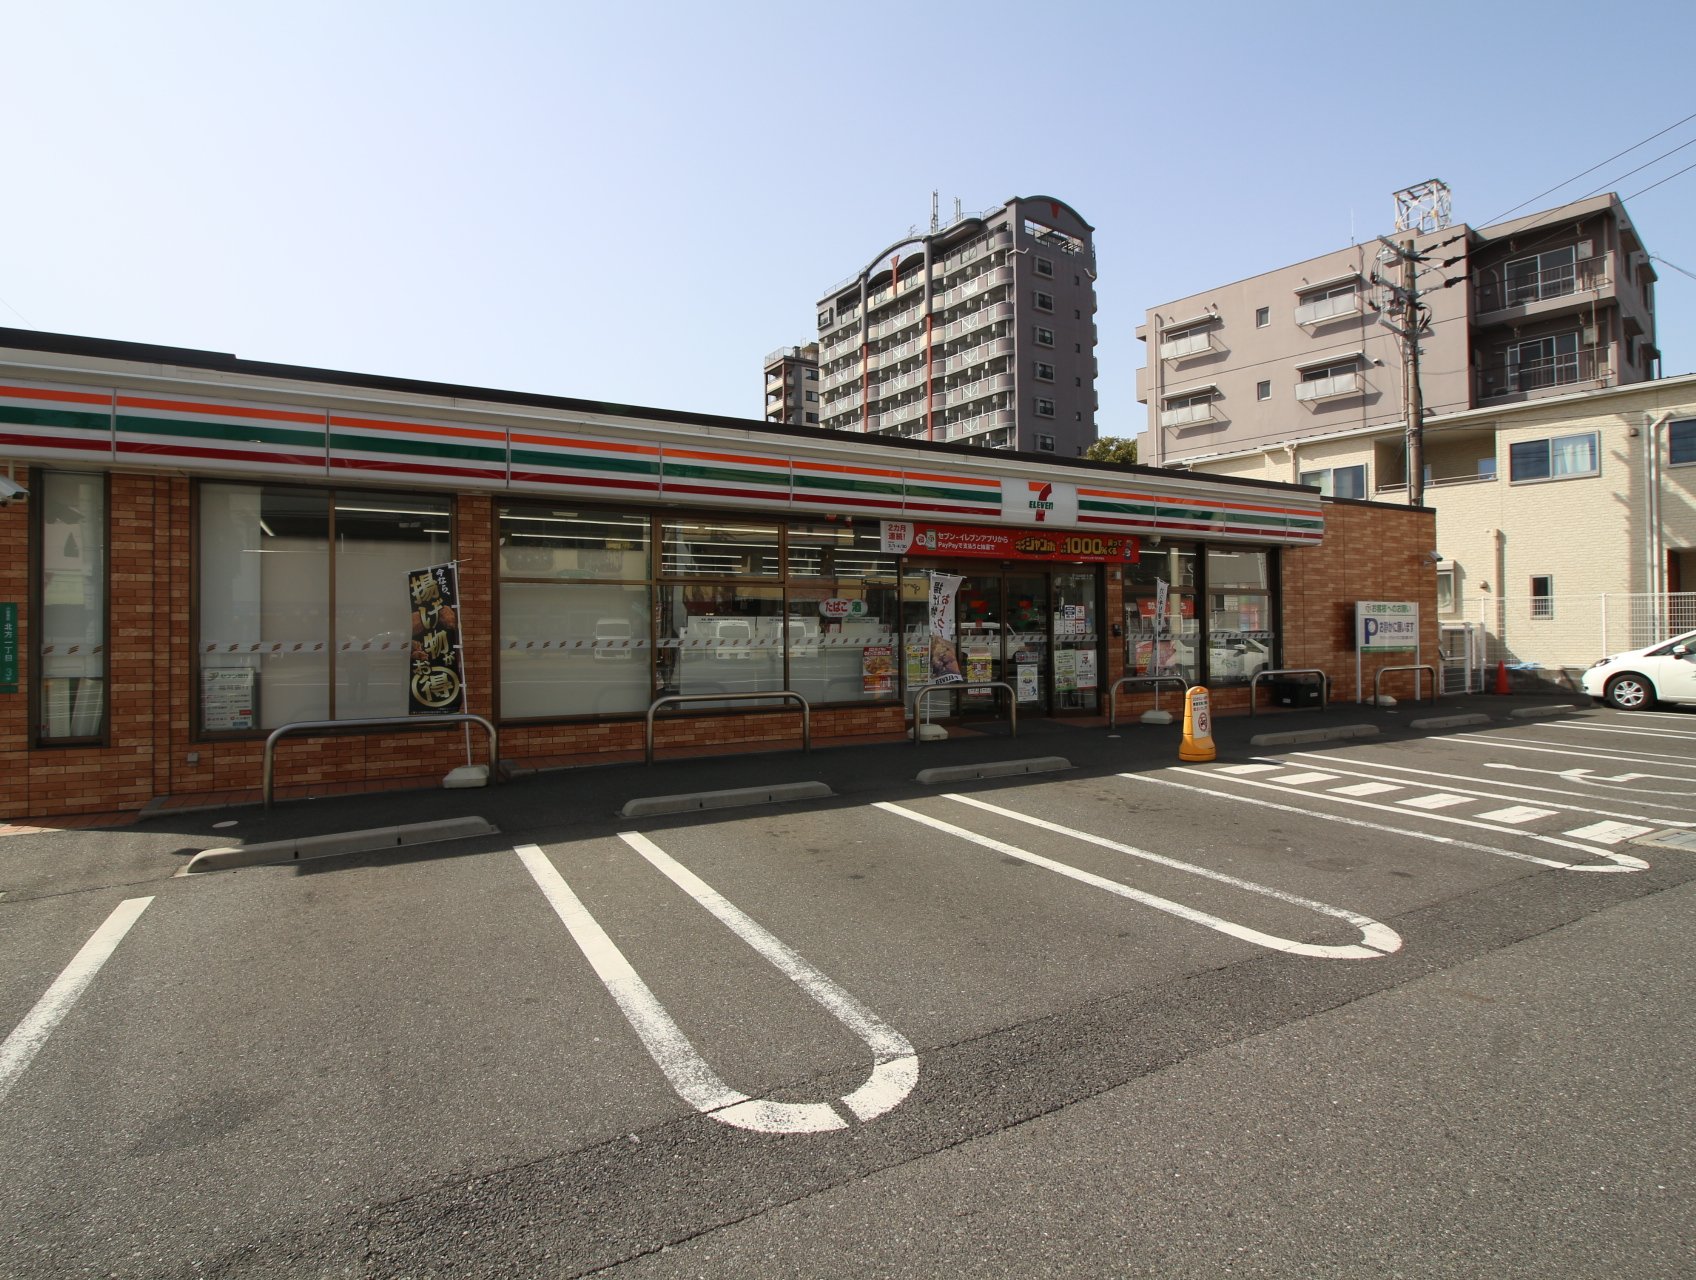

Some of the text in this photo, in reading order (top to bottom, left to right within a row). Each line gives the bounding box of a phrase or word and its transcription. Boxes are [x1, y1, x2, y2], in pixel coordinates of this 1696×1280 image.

[1029, 481, 1052, 521] 7
[825, 601, 848, 613] たばこ
[1364, 618, 1378, 644] P
